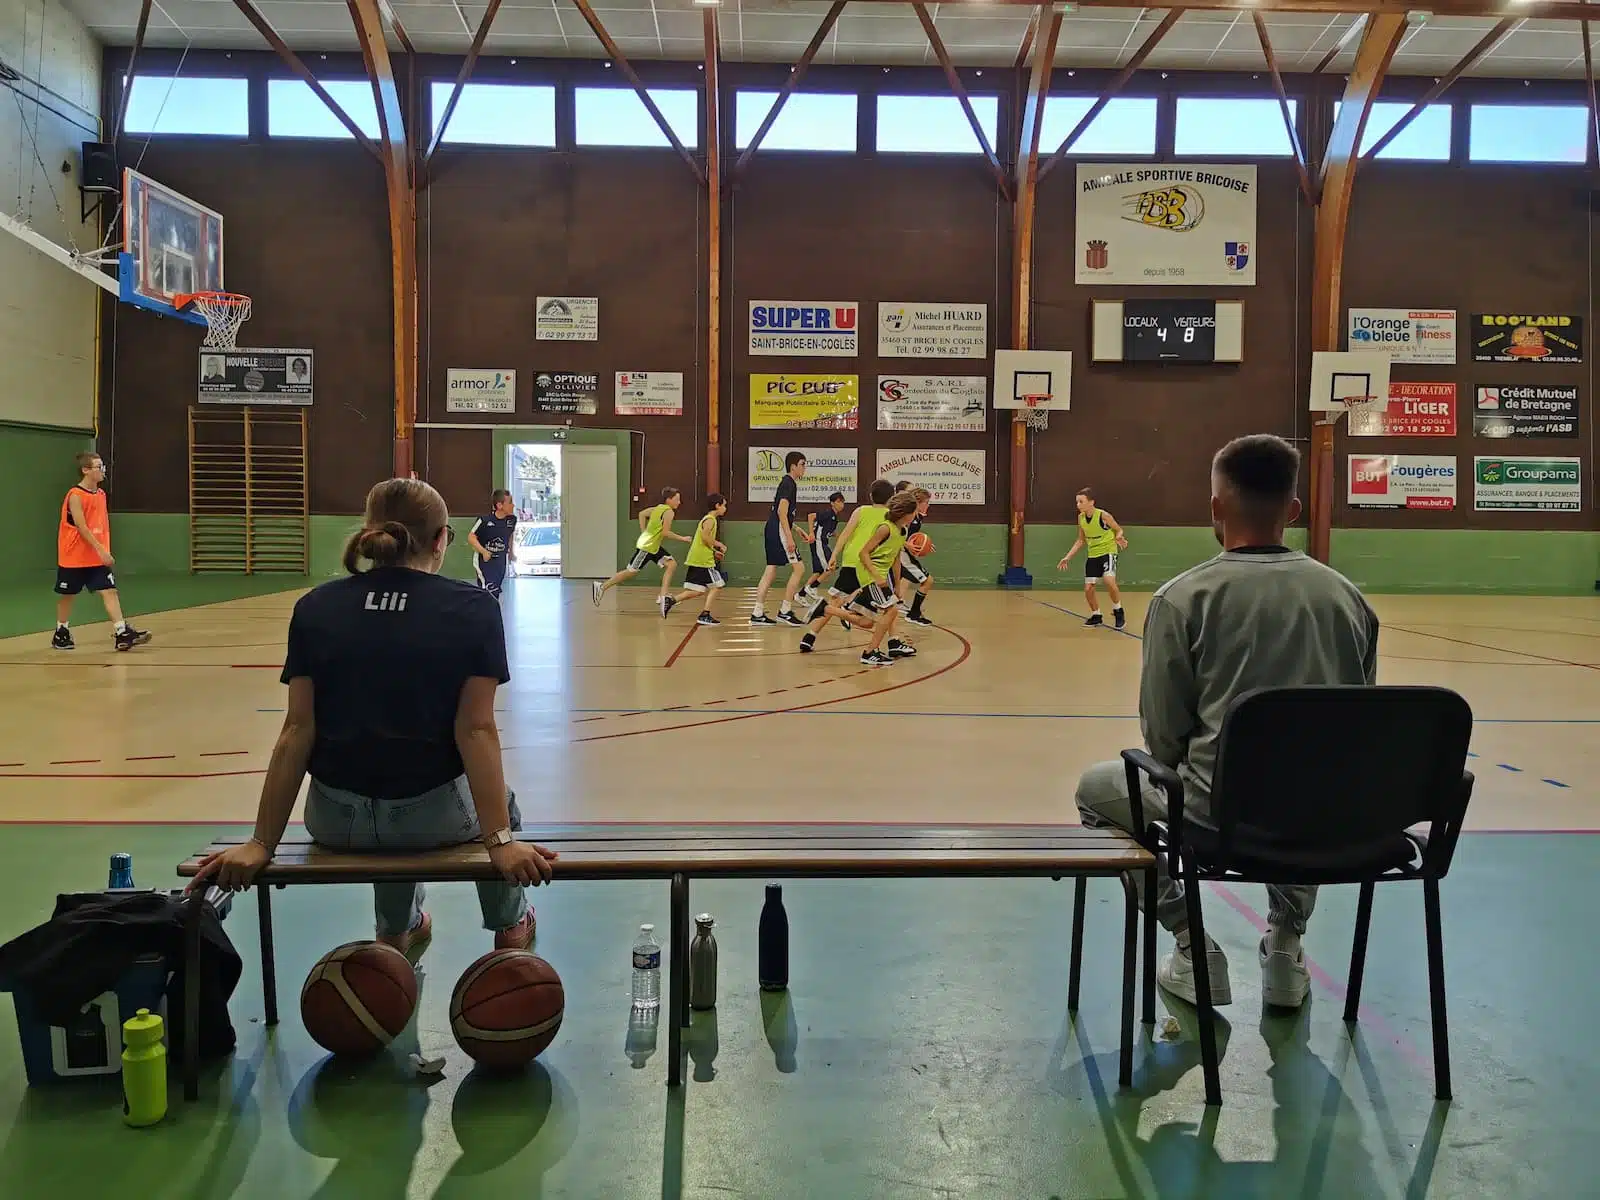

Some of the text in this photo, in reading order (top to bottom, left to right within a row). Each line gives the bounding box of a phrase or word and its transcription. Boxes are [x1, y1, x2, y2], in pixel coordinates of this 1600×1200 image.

[1083, 169, 1250, 194] AMICALE SPORTIVE BRICOISE
[1143, 268, 1165, 277] depuis
[752, 306, 856, 329] SUPER U
[886, 314, 903, 322] gan
[915, 311, 982, 321] Michel HUARD
[1124, 317, 1215, 328] LOCAUX VISITEURS
[1354, 317, 1411, 331] l'Orange
[1157, 328, 1194, 342] 4 8
[1372, 330, 1410, 342] bleue
[1416, 329, 1452, 340] Fitness
[961, 347, 971, 355] 27
[226, 357, 258, 368] NOUVELLE
[451, 380, 490, 389] armor
[554, 375, 597, 384] OPTIQUE
[802, 382, 837, 394] PUB
[950, 387, 984, 396] Coglais
[1401, 386, 1452, 395] DECORATION
[1501, 388, 1576, 399] Crédit Mutuel
[755, 399, 784, 407] Marquage
[1505, 399, 1571, 412] de Bretagne
[1404, 402, 1449, 416] LIGER
[1545, 424, 1572, 432] l'ASB
[815, 459, 856, 467] DOUAGLIN
[879, 453, 982, 476] AMBULANCE COGLAISE
[1355, 471, 1381, 482] BUT
[1391, 464, 1455, 478] Fougères
[1506, 467, 1577, 480] Groupama
[948, 493, 959, 501] 72
[364, 591, 408, 611] Lili
